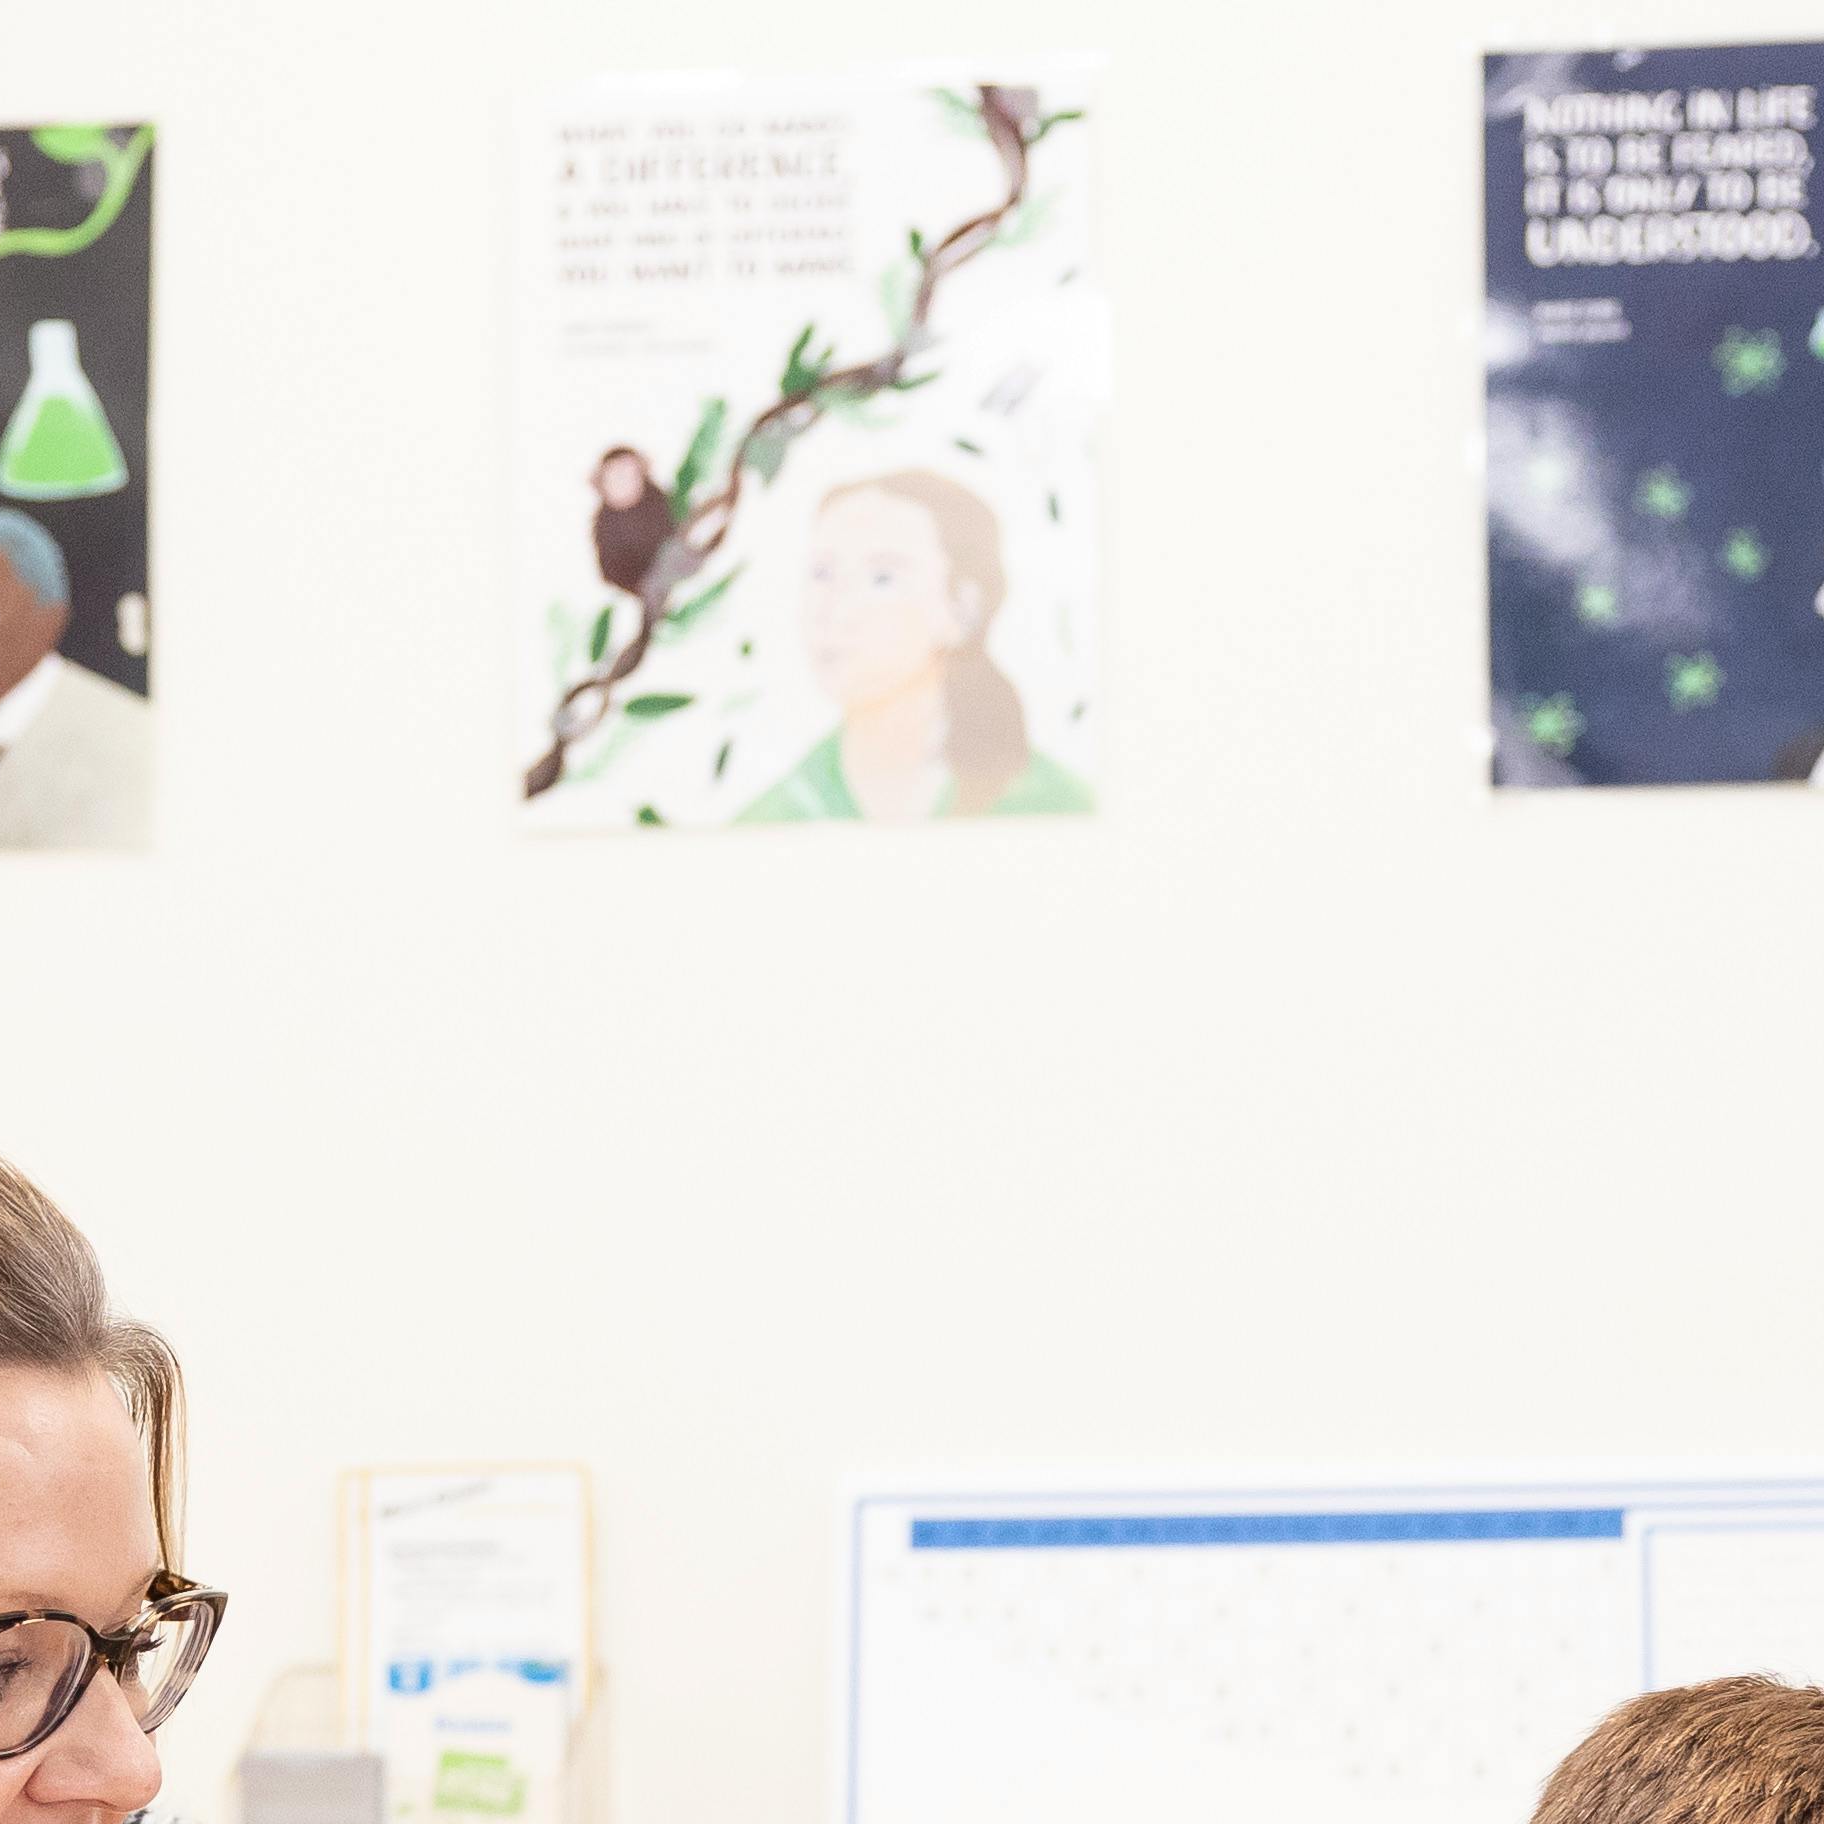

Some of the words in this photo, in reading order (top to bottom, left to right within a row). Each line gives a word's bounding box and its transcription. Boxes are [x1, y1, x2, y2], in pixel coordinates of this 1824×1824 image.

[1524, 91, 1684, 133] NOTHING
[1686, 87, 1734, 131] IN
[1736, 85, 1818, 131] LIFE
[1603, 172, 1703, 213] ONLY
[1706, 170, 1755, 211] TO
[1757, 169, 1809, 211] BE
